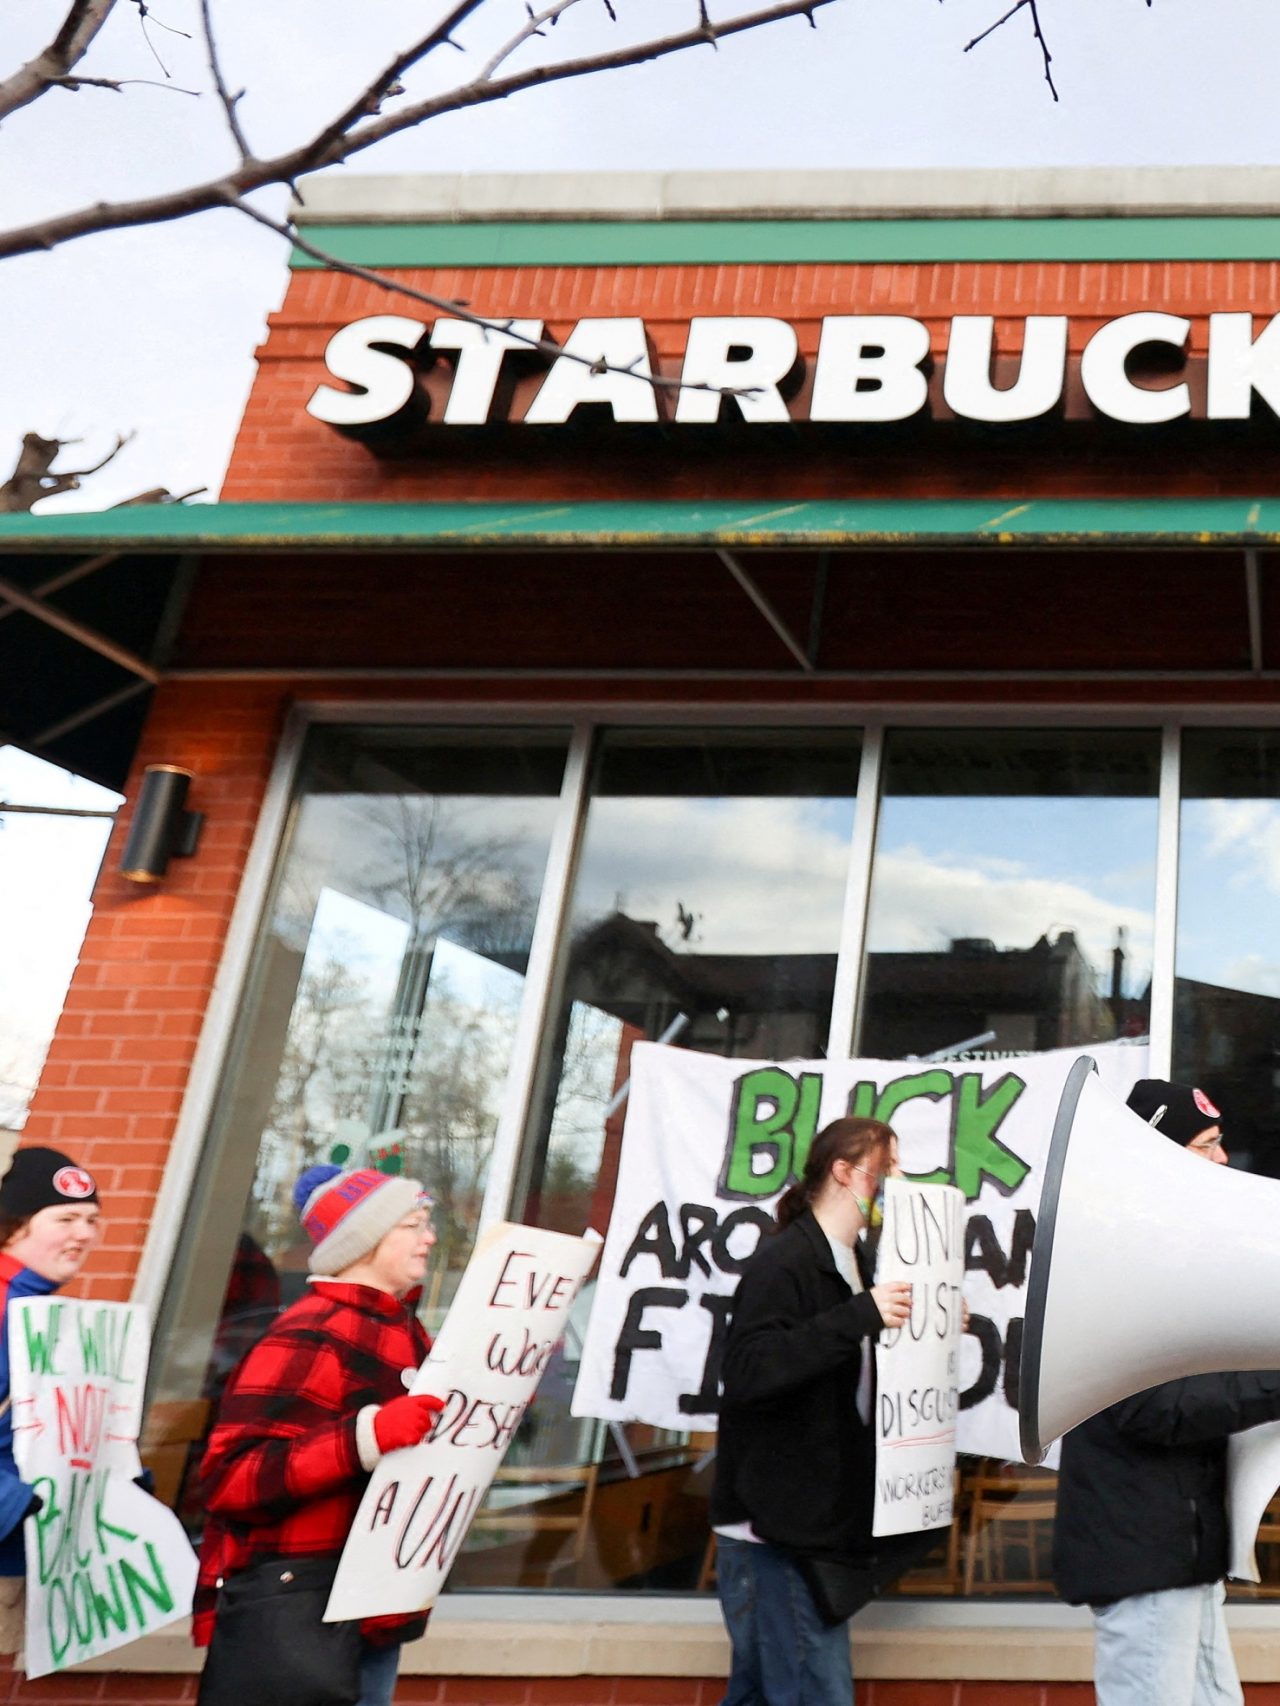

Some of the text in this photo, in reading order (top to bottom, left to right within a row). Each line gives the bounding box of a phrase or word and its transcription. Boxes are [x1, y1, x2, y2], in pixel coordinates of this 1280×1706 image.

[715, 1066, 1032, 1203] BUCK
[619, 1199, 776, 1279] ARO
[22, 1303, 65, 1376] WE
[609, 1286, 738, 1415] FI
[54, 1383, 109, 1458] NOT
[370, 1473, 477, 1572] A UN
[47, 1541, 174, 1664] DOWN
